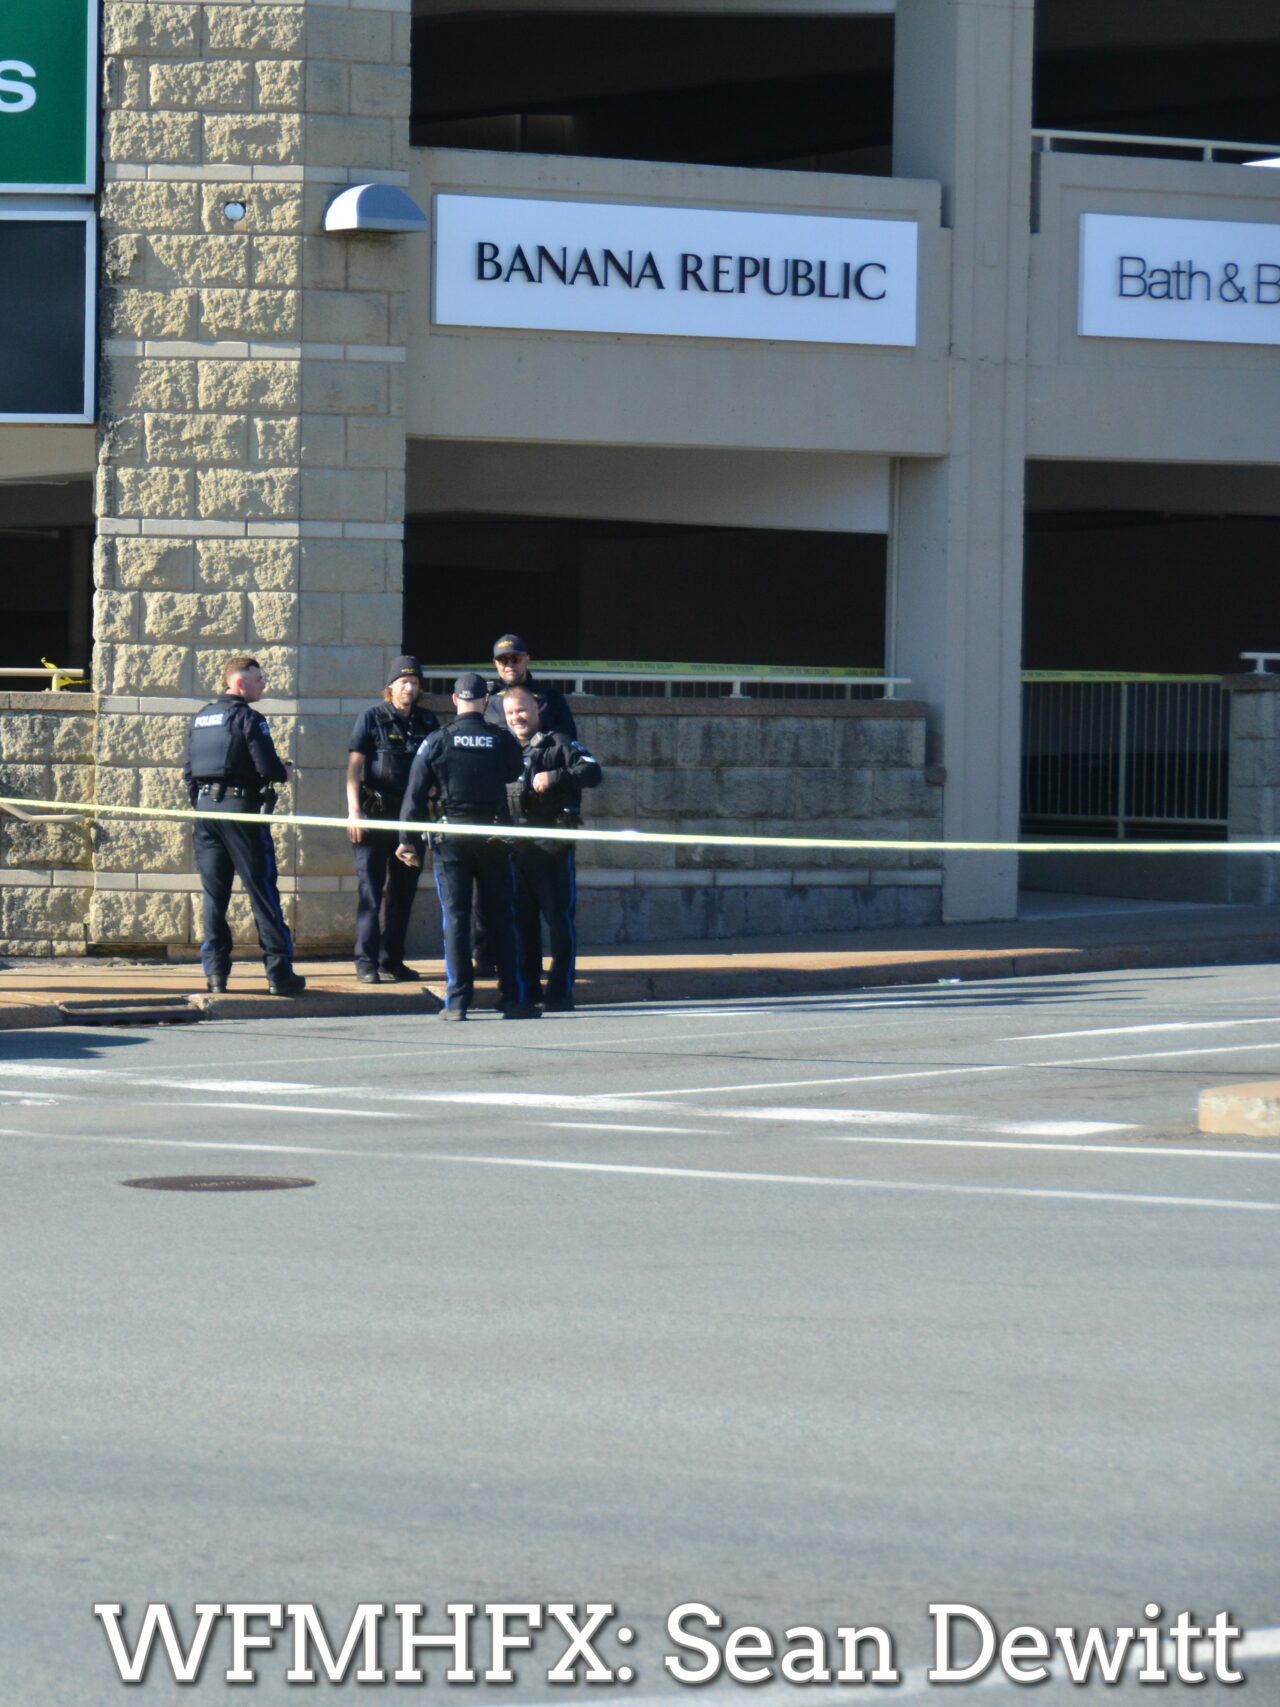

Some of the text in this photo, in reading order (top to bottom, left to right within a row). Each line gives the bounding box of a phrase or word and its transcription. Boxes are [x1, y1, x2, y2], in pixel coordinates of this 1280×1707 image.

[476, 241, 888, 302] BANANA REPUBLIC
[1118, 255, 1211, 301] Bath
[1219, 261, 1249, 304] &
[453, 735, 494, 748] POLICE
